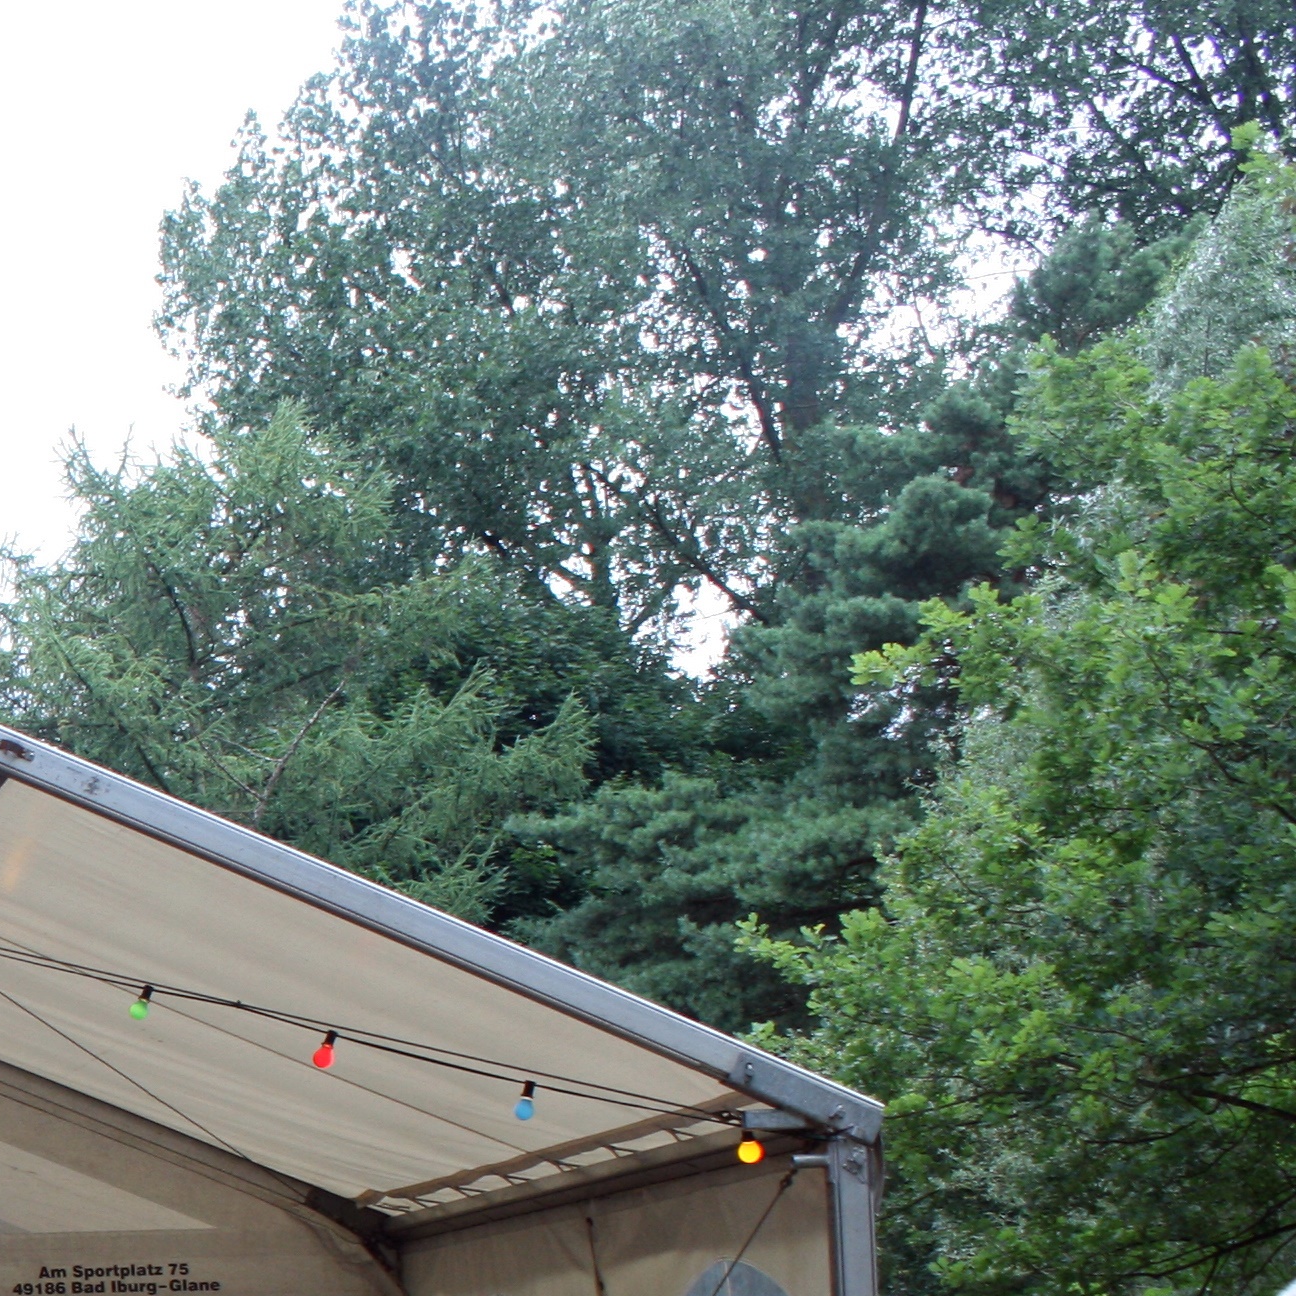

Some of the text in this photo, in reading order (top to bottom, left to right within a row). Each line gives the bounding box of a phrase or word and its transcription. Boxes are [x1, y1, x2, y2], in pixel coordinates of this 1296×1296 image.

[38, 1263, 190, 1281] Am Sportplatz 75
[12, 1279, 221, 1296] 49186 Bad Iburg-Glane
